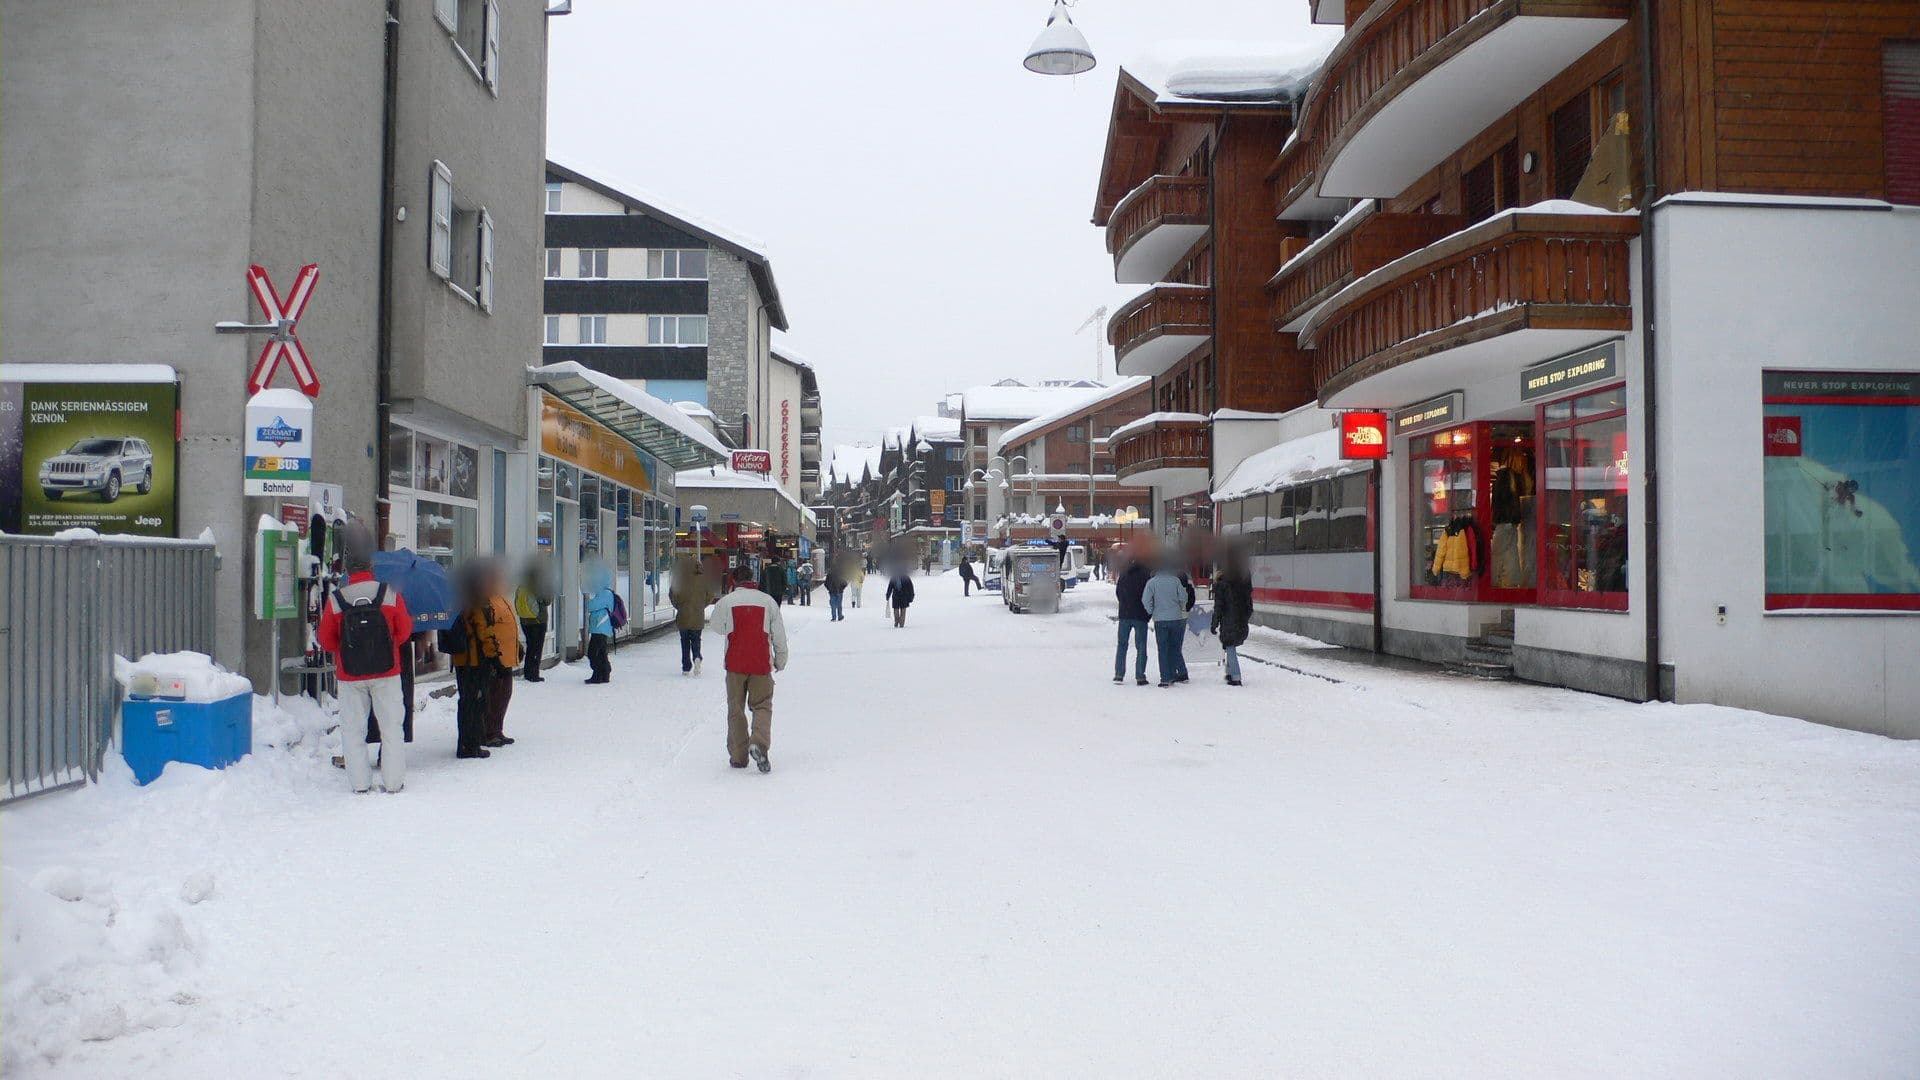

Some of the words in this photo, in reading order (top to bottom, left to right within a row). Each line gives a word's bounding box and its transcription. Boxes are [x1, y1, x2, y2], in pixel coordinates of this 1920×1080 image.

[1528, 375, 1548, 390] NEVER
[1549, 370, 1566, 384] STOP
[1567, 358, 1606, 379] EXPLORING
[1783, 381, 1818, 390] NEVER
[1822, 381, 1848, 391] STOP
[1851, 382, 1910, 392] EXPLORING
[31, 401, 59, 412] DANK
[61, 400, 148, 412] SERIENMÄSSIGEM
[30, 413, 68, 424] XENON.
[262, 428, 298, 437] ZERMATT
[781, 399, 790, 486] GORNERGRAT
[263, 482, 294, 494] Bahnhof
[135, 515, 162, 527] Jeep
